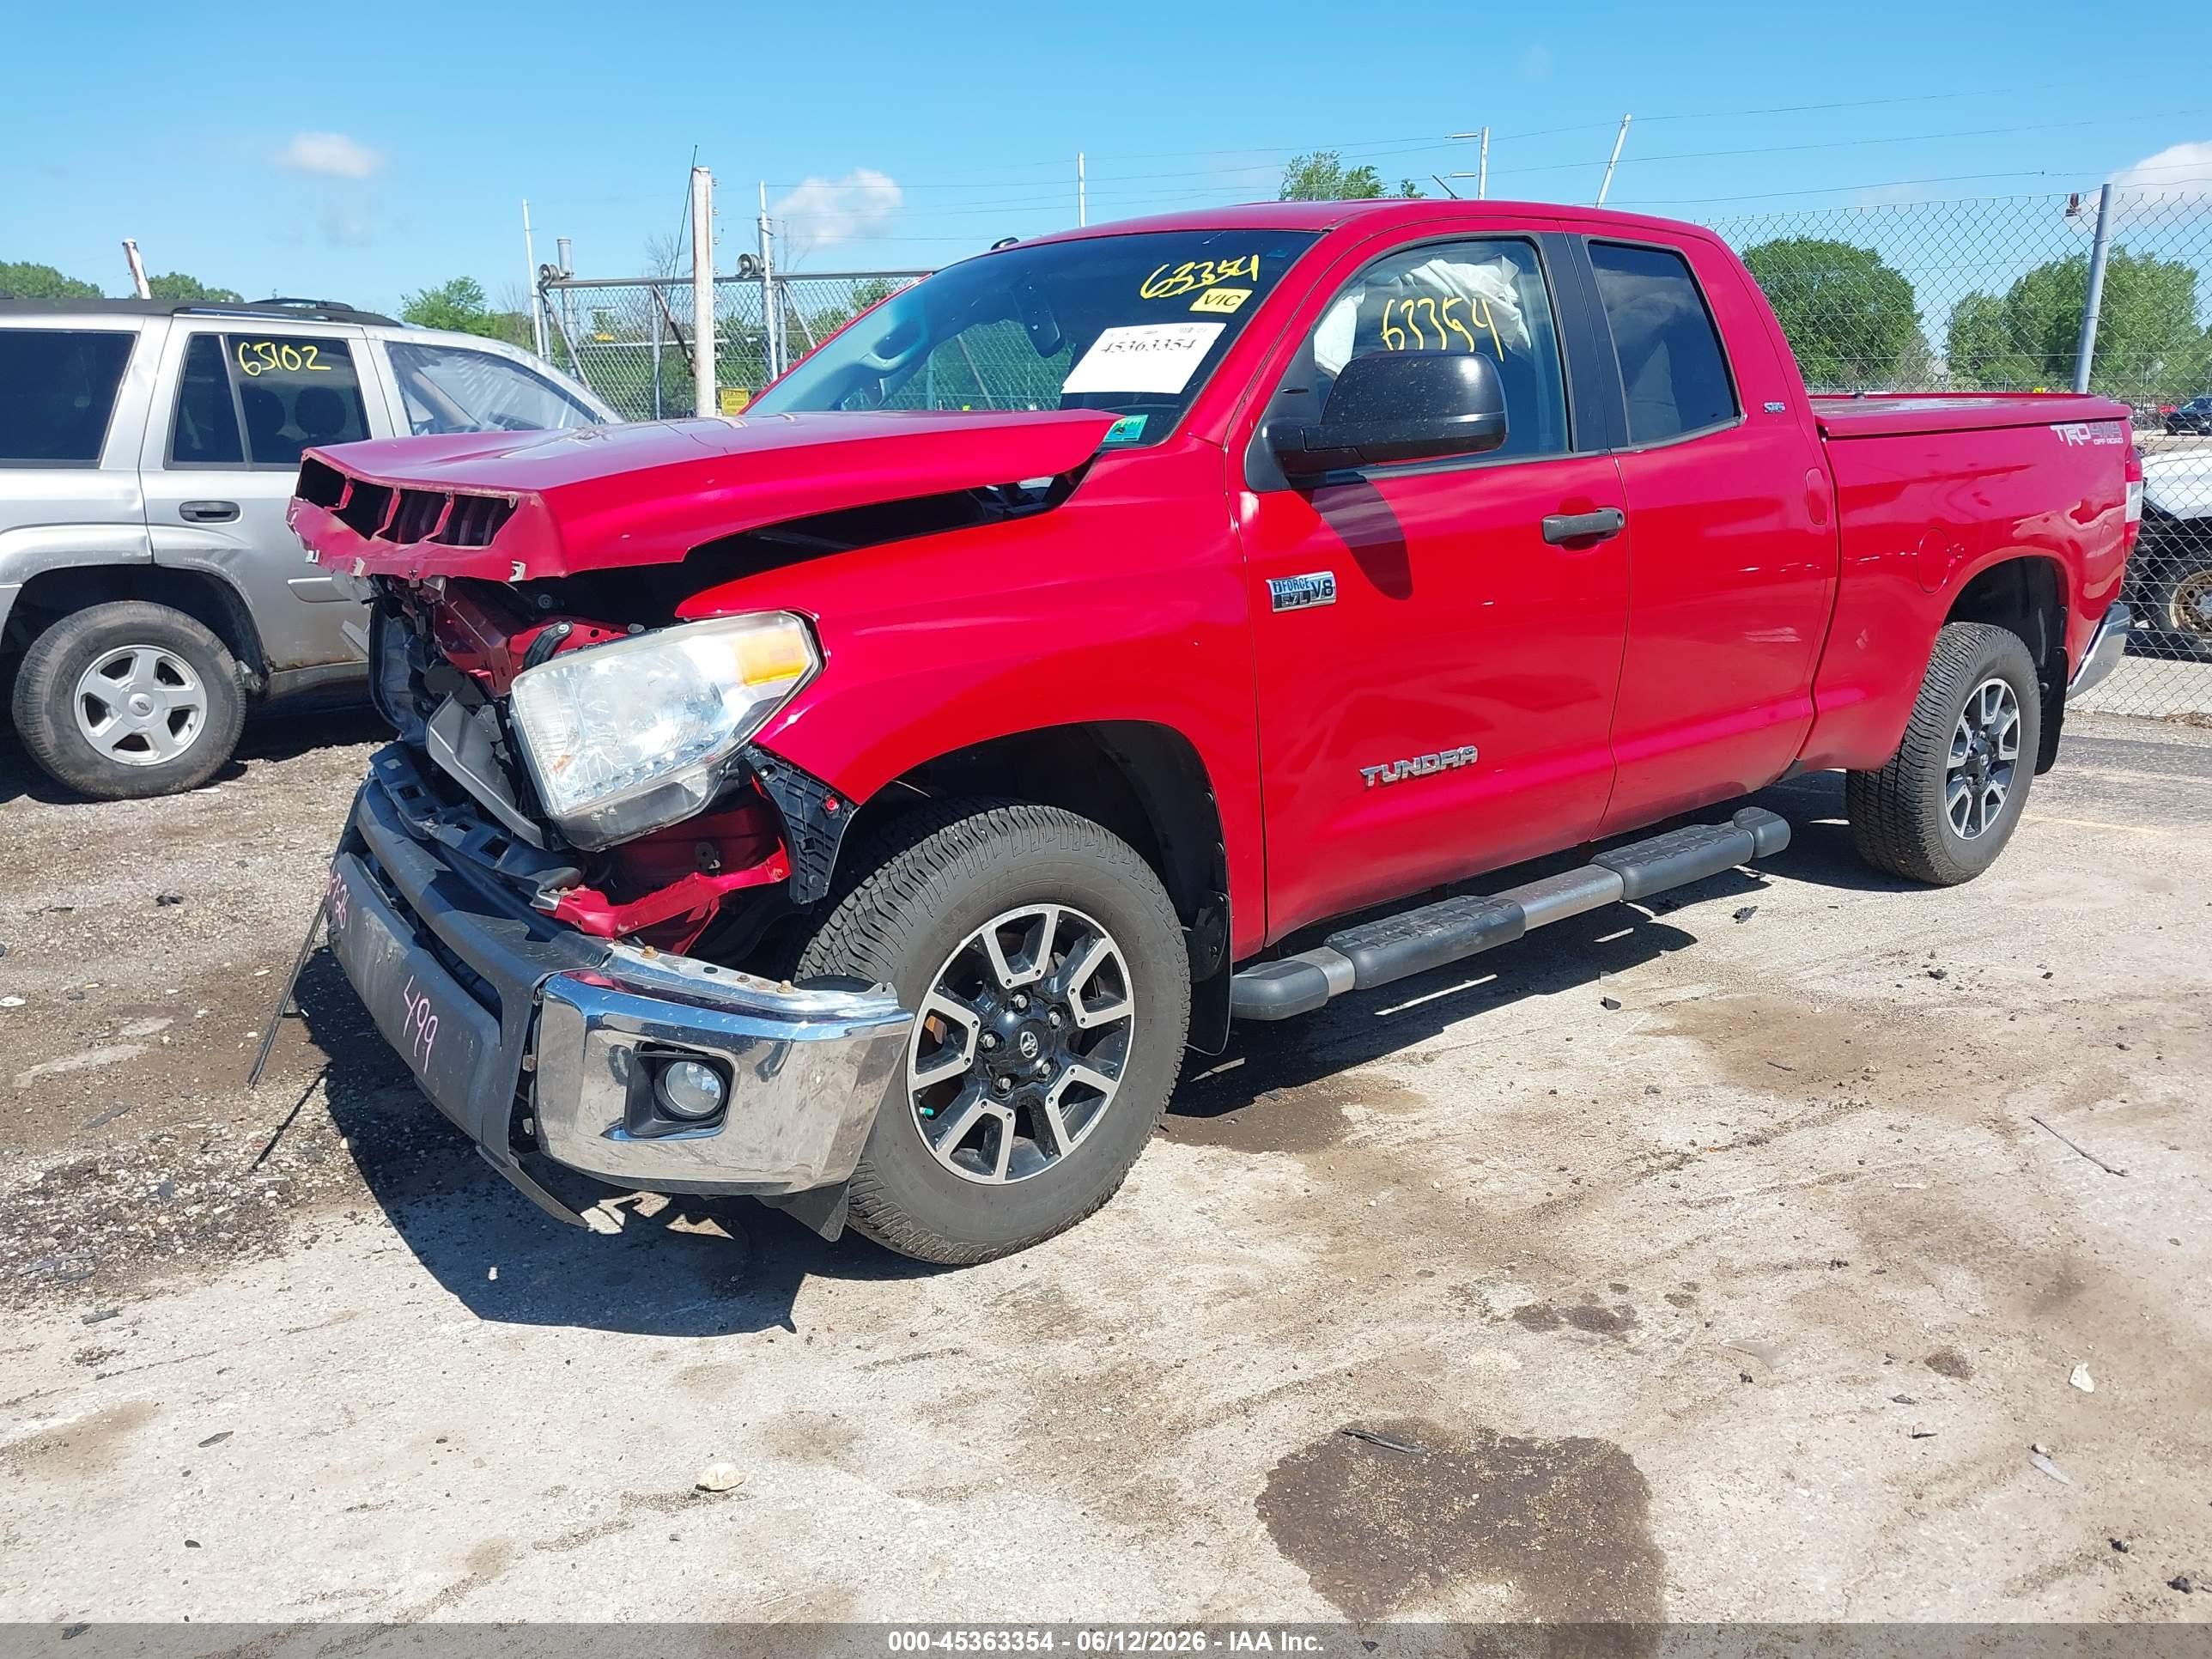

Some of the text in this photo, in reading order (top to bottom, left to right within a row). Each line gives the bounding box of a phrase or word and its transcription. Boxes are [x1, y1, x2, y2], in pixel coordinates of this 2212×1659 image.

[1204, 295, 1242, 307] VIC
[238, 342, 331, 376] 65102
[2050, 423, 2092, 447] TRD
[1310, 579, 1334, 599] V8
[1360, 745, 1478, 787] TUNDRA
